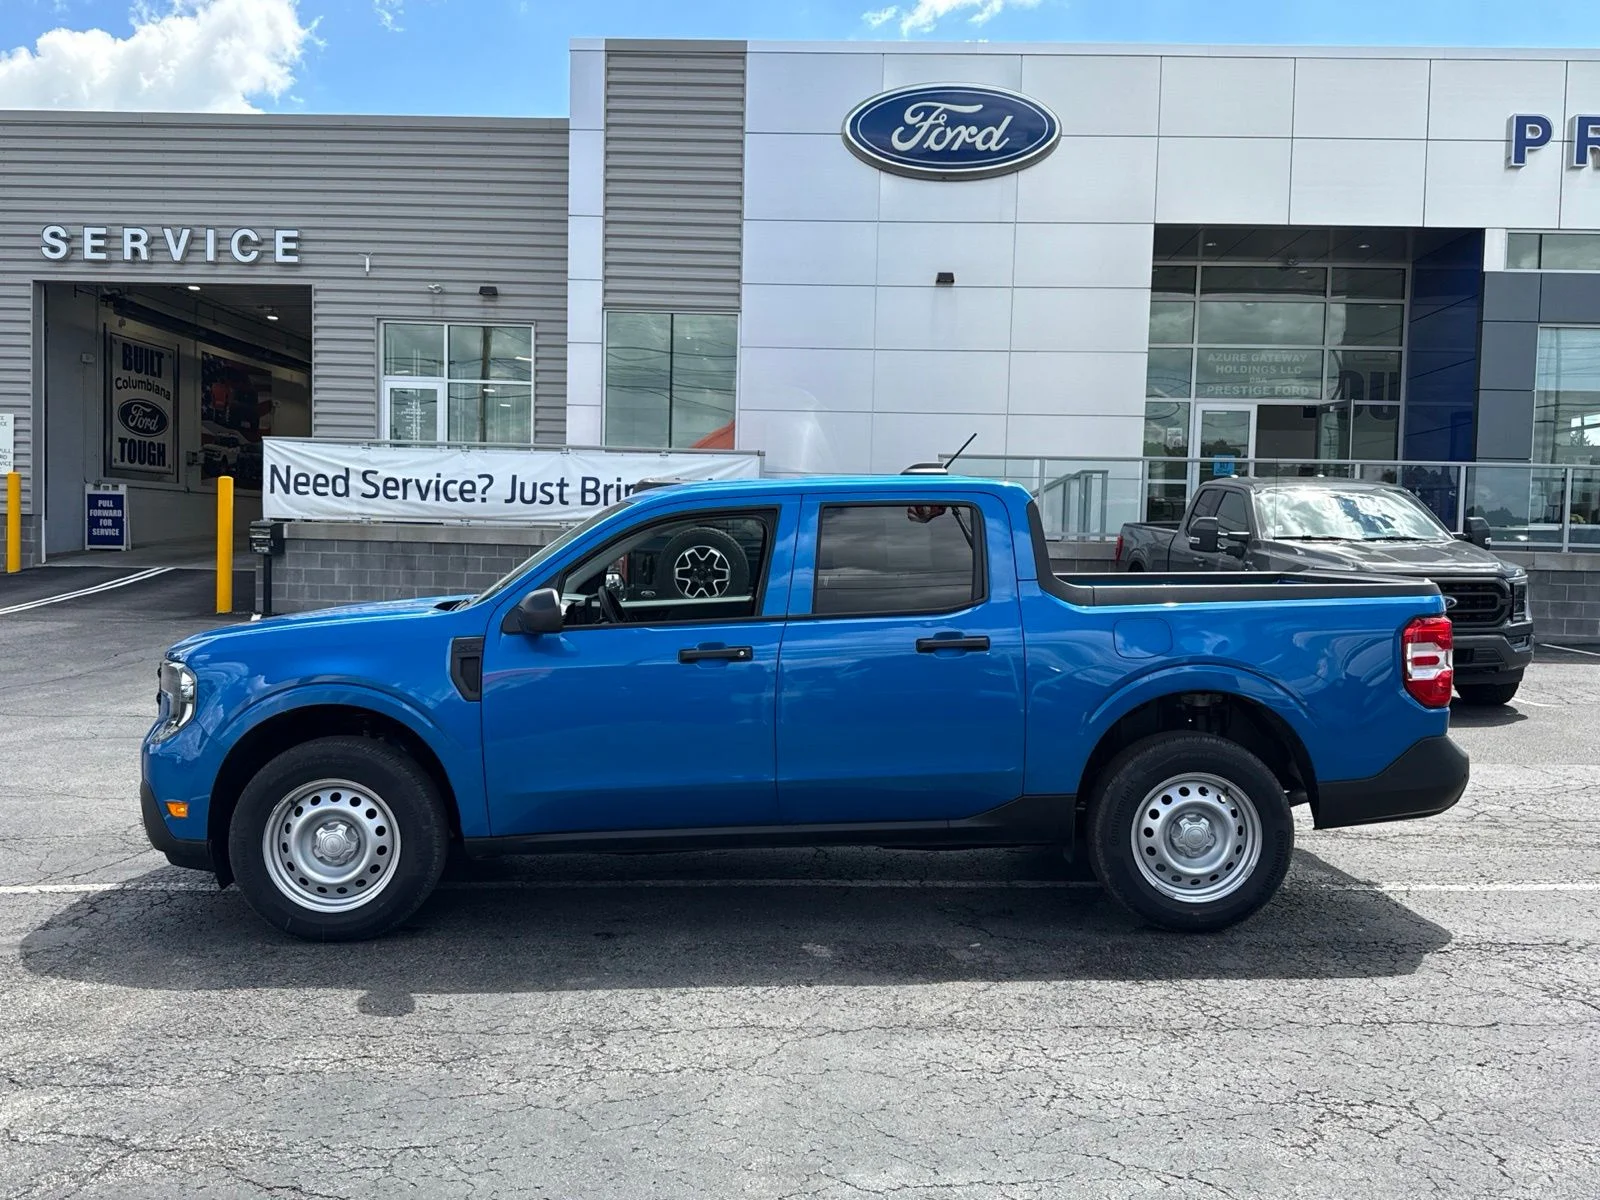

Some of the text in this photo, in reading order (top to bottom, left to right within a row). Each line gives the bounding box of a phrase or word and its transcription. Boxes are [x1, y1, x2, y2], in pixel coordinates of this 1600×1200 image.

[891, 101, 1014, 151] Ford
[1506, 114, 1600, 169] PR
[41, 225, 300, 263] SERVICE
[121, 342, 164, 378] BUILT
[1208, 352, 1308, 362] AZURE GATEWAY
[1215, 365, 1302, 374] HOLDINGS LLC
[115, 376, 171, 400] Columbiana
[1206, 385, 1309, 395] PRESTIGE FORD
[128, 404, 159, 431] Ford
[118, 437, 166, 467] TOUGH
[269, 464, 350, 498] Need
[361, 470, 494, 503] Service?
[504, 475, 570, 506] Just
[90, 509, 122, 517] FORWARD
[98, 500, 114, 508] PULL
[92, 528, 120, 536] SERVICE
[99, 519, 113, 527] FOR
